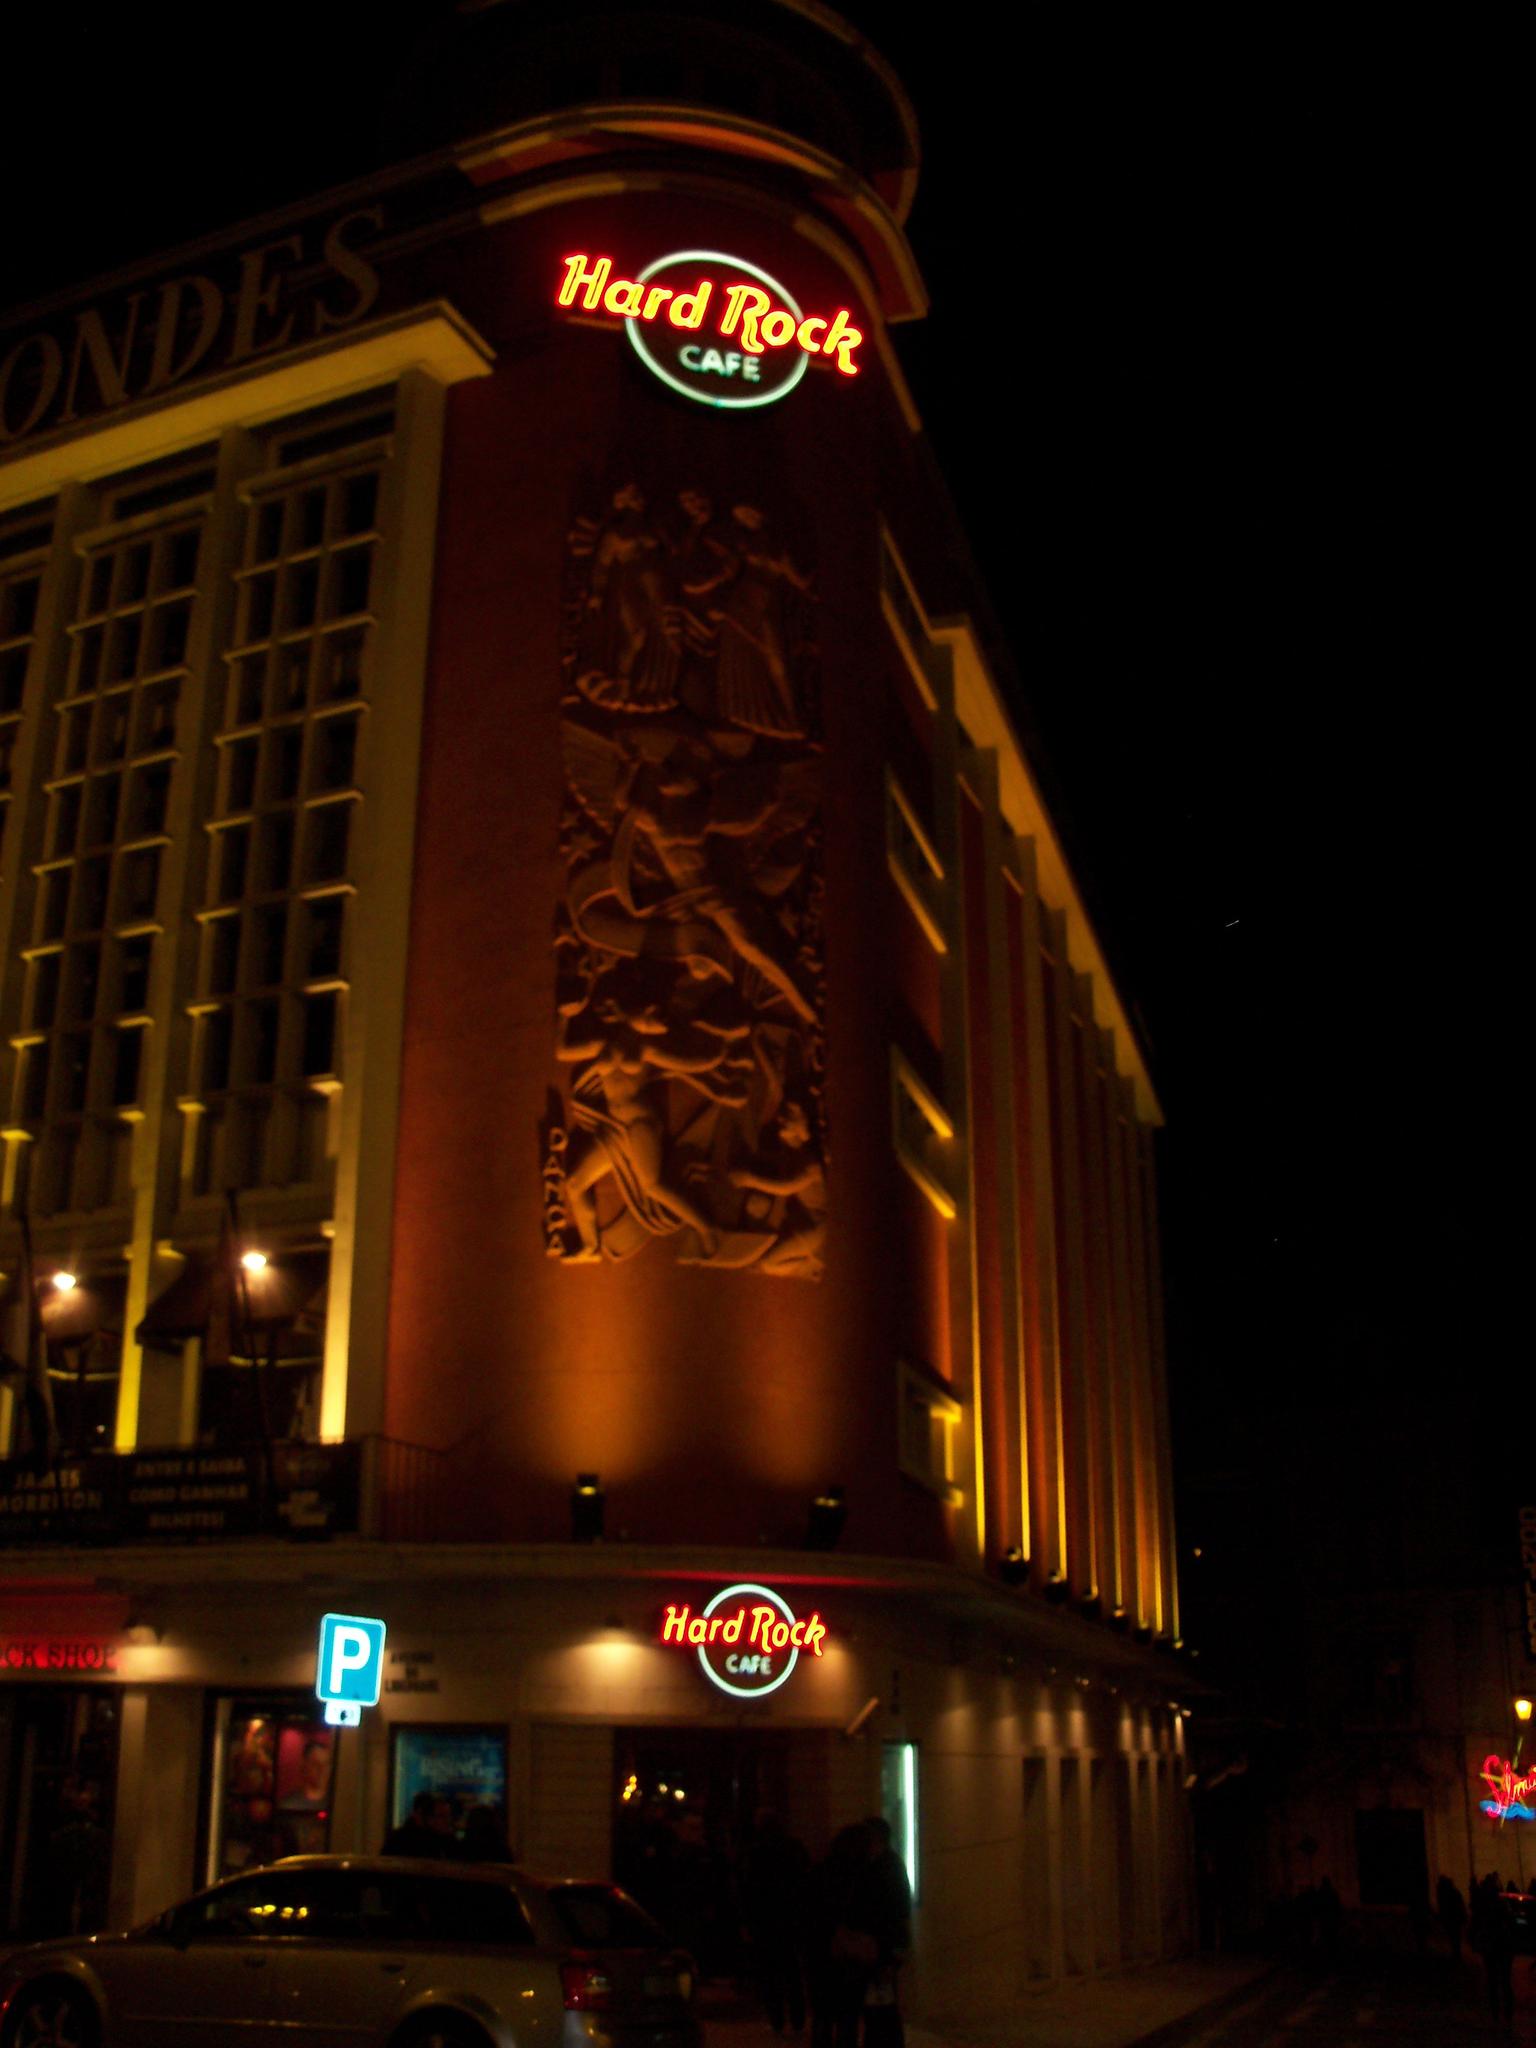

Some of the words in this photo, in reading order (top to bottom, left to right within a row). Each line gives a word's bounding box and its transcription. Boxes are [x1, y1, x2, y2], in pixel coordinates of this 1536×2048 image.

[557, 252, 714, 330] Hard
[718, 283, 864, 377] Rock
[677, 344, 762, 384] CAFE
[662, 1605, 746, 1644] Hard
[750, 1605, 827, 1657] Rock
[328, 1625, 371, 1694] P
[724, 1652, 772, 1676] CAFE
